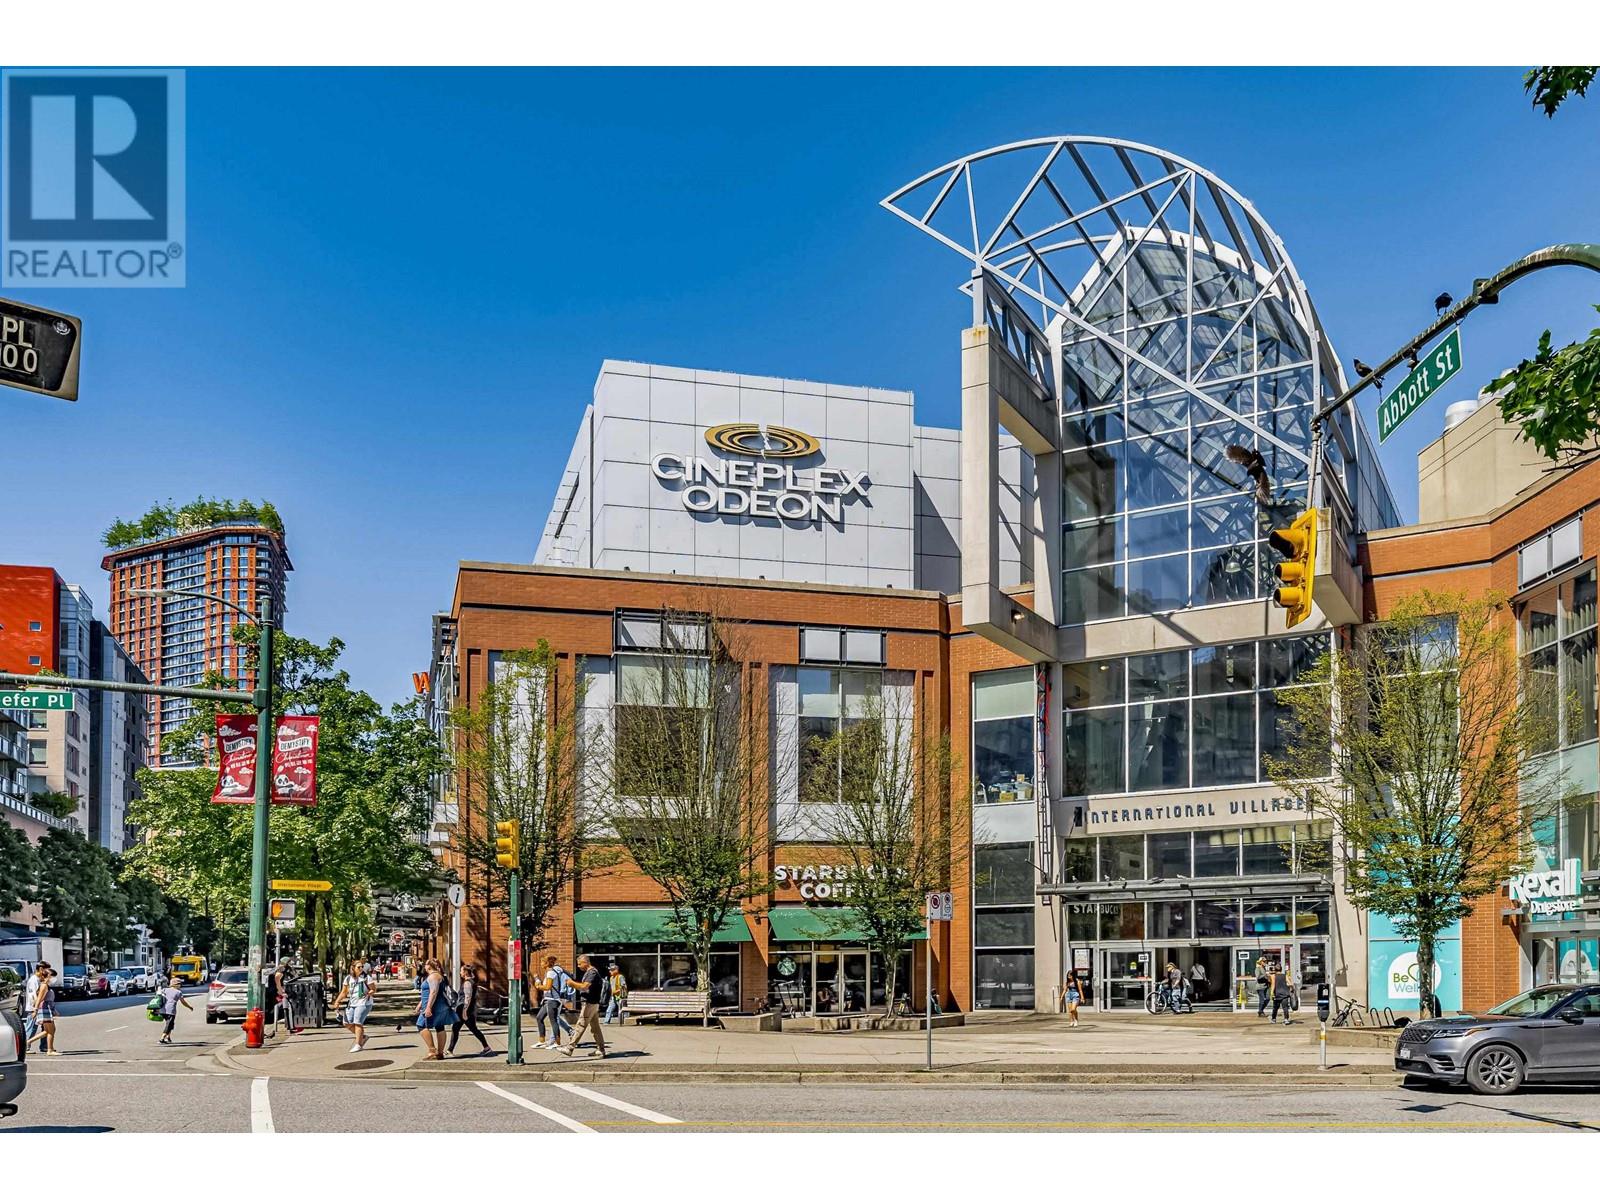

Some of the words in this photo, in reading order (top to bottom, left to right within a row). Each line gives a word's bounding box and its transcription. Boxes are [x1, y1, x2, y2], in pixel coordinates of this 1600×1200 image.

[2, 316, 33, 348] PL
[1383, 367, 1430, 434] Abbott
[1435, 344, 1454, 380] St
[651, 453, 869, 497] CINEPLEX
[681, 485, 841, 522] ODEON
[2, 693, 39, 707] efer
[47, 694, 65, 707] Pl
[1084, 803, 1215, 825] INTERNATIONAL
[1229, 797, 1304, 815] VILLAGE
[774, 864, 908, 881] STARBCS
[1509, 858, 1581, 904] Rexall
[800, 882, 884, 899] COFF
[1531, 900, 1577, 915] Drugstore
[1393, 973, 1409, 982] Be
[1394, 983, 1419, 993] Well
